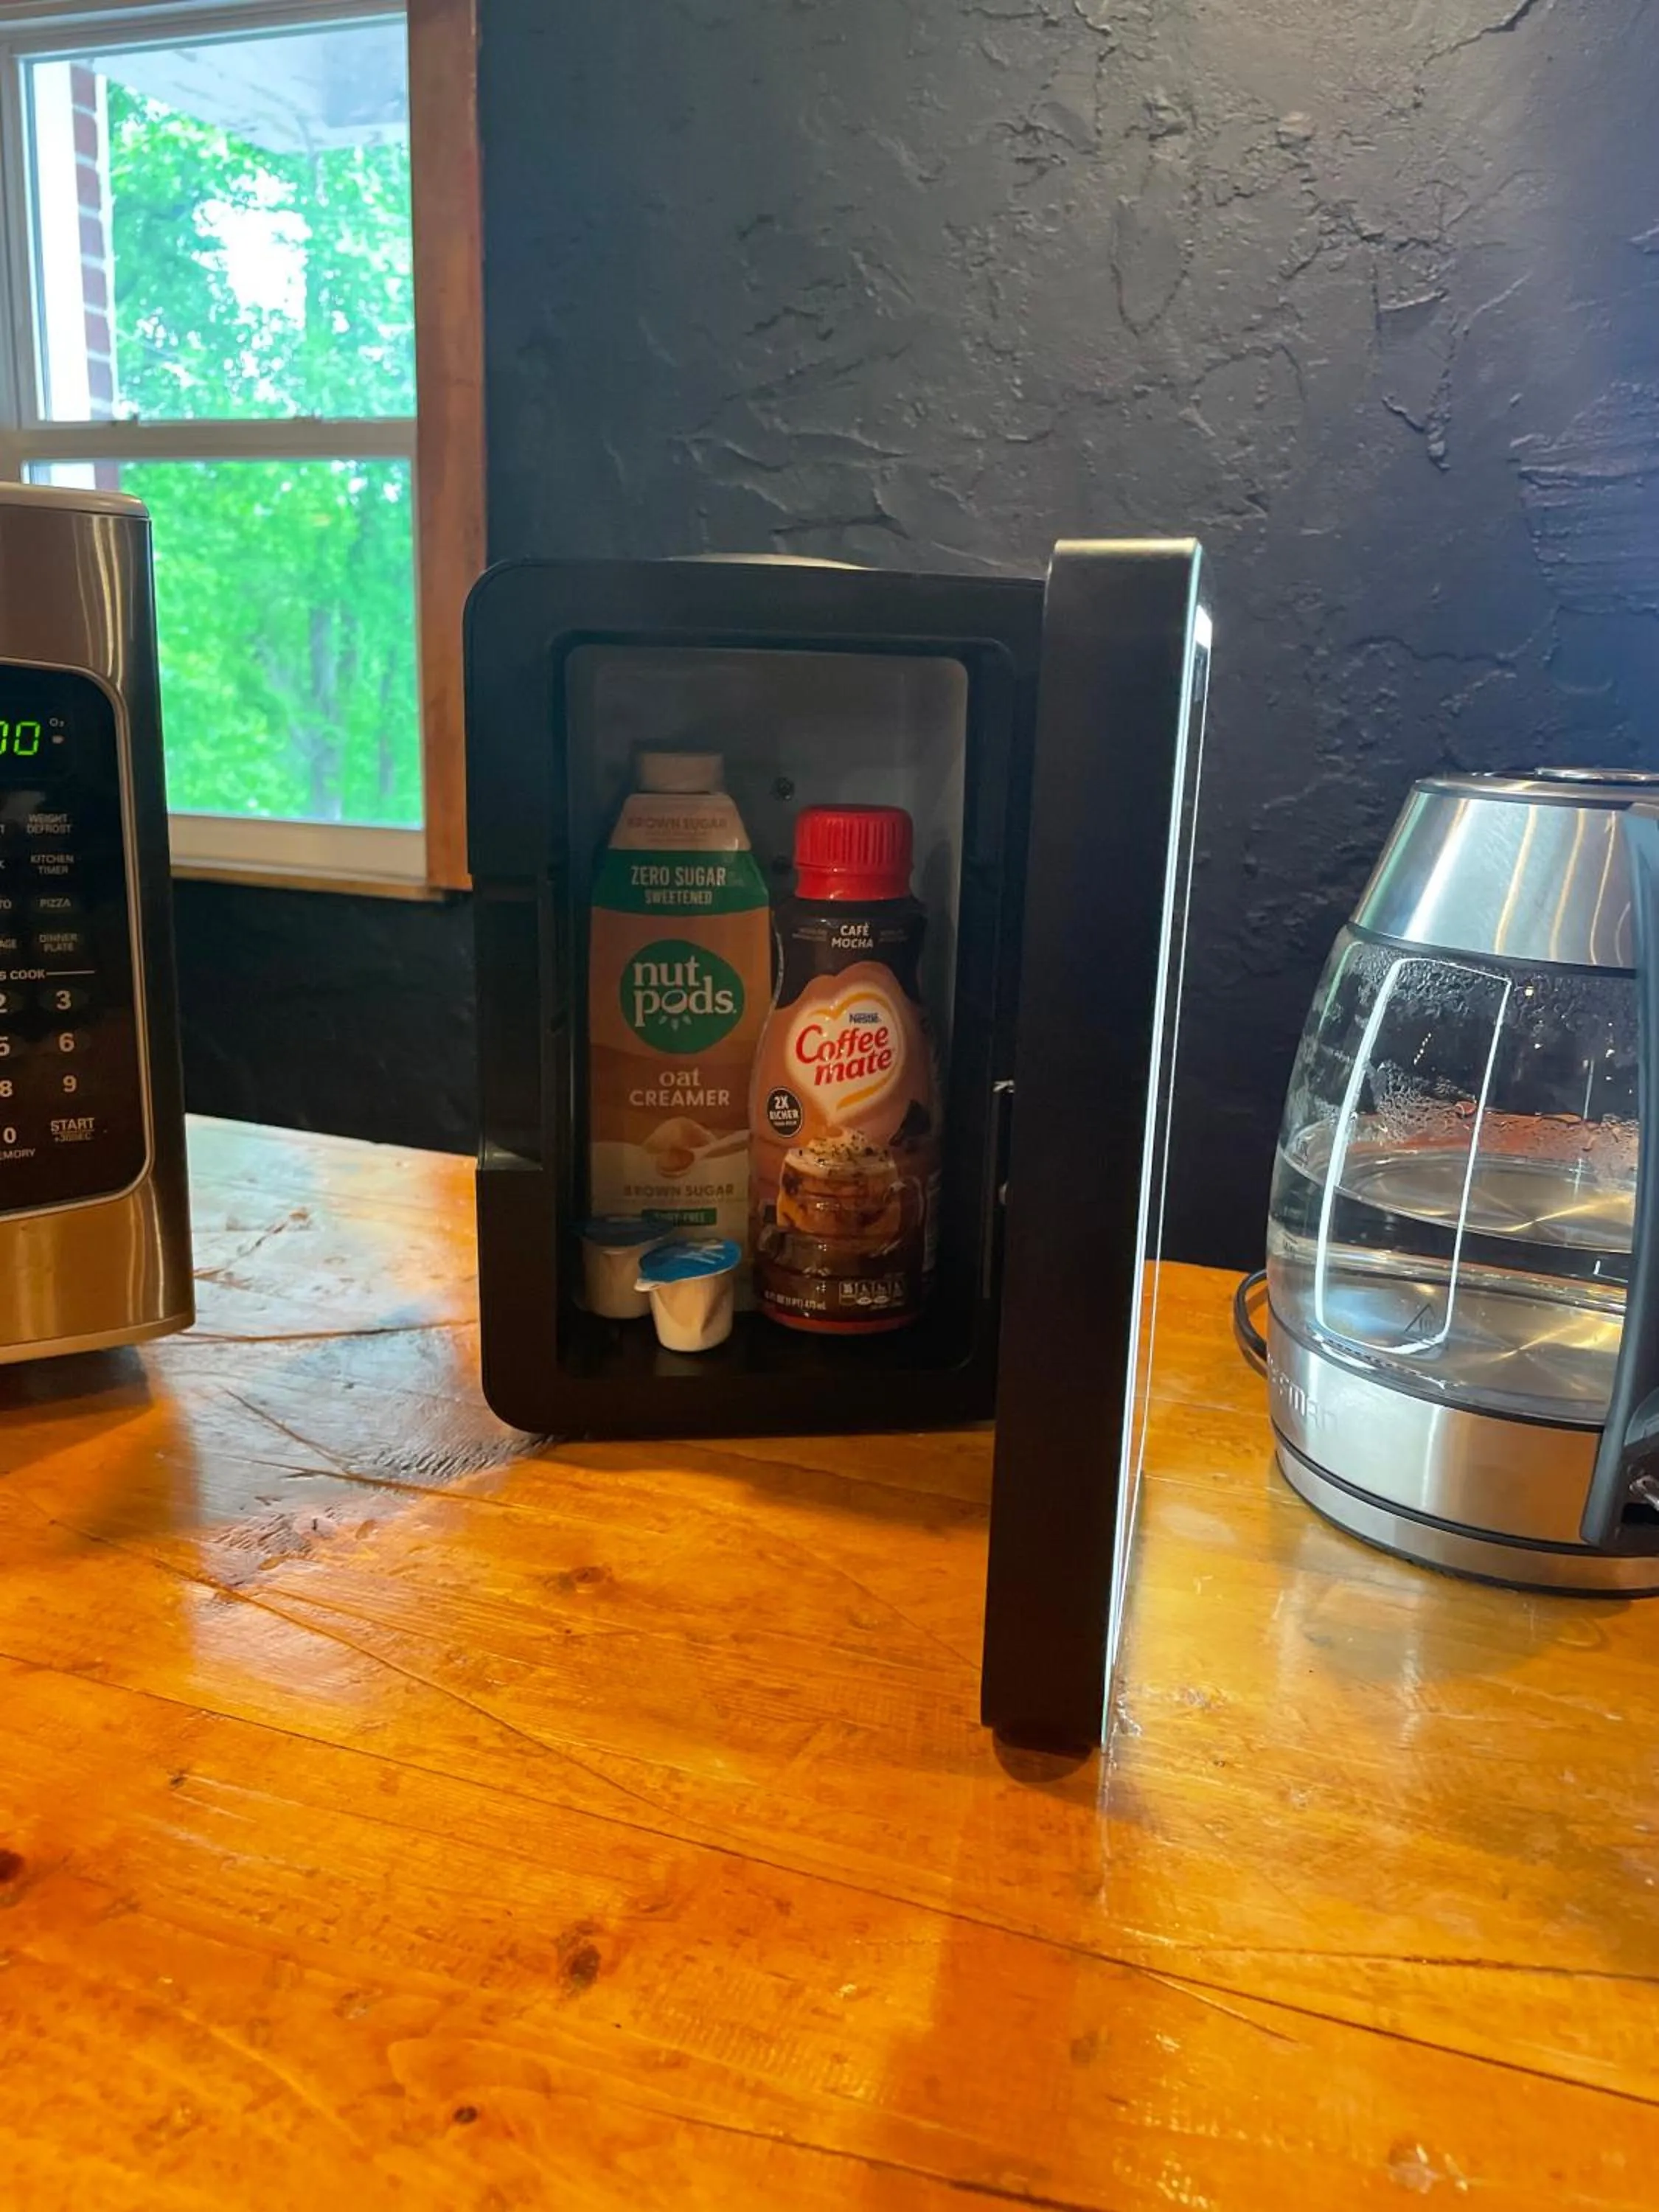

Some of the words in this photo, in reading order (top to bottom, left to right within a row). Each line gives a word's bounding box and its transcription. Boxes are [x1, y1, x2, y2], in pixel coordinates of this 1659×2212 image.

[30, 854, 74, 863] KITCHEN
[38, 864, 69, 875] TIMER
[630, 866, 669, 886] ZERO
[675, 866, 726, 886] SUGAR
[40, 897, 72, 908] PIZZA
[644, 889, 713, 905] SWEETENED
[839, 921, 870, 936] CAFÉ
[39, 933, 78, 942] DINNER
[830, 936, 874, 949] MOCHA
[44, 942, 74, 952] PLATE
[10, 969, 45, 981] COOK
[633, 956, 700, 987] nut
[55, 990, 72, 1010] 3
[59, 1032, 74, 1052] 6
[795, 1023, 889, 1064] Coffee
[813, 1047, 893, 1086] mate
[63, 1074, 77, 1093] 9
[658, 1067, 702, 1088] oat
[0, 1079, 13, 1098] 8
[628, 1090, 730, 1107] CREAMER
[774, 1096, 789, 1109] 2X
[769, 1109, 799, 1120] RICHER
[50, 1117, 95, 1133] START
[3, 1127, 16, 1144] 0
[623, 1184, 681, 1197] BROWN
[685, 1183, 734, 1197] SUGAR
